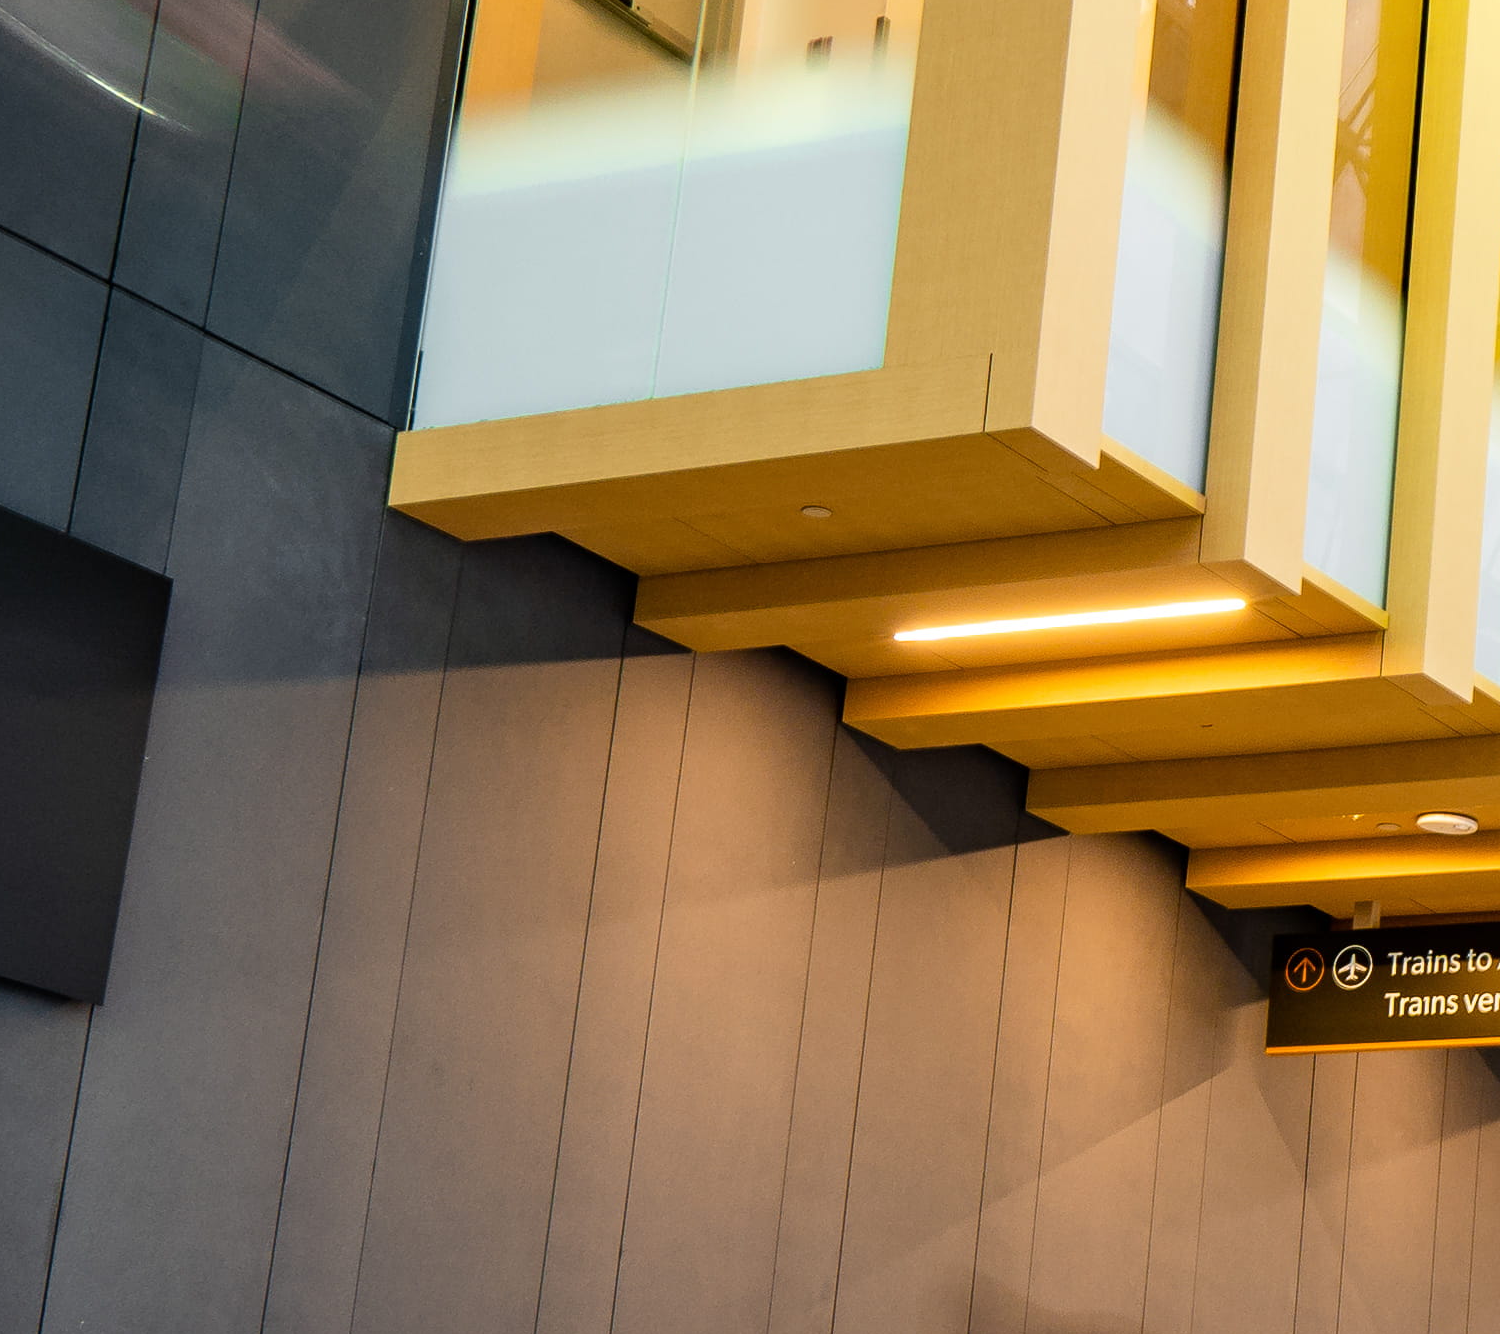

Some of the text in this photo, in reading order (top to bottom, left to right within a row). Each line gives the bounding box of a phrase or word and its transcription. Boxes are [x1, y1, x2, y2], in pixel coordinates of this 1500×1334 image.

[1387, 949, 1461, 977] Trains
[1466, 948, 1493, 973] to
[1384, 991, 1460, 1018] Trains
